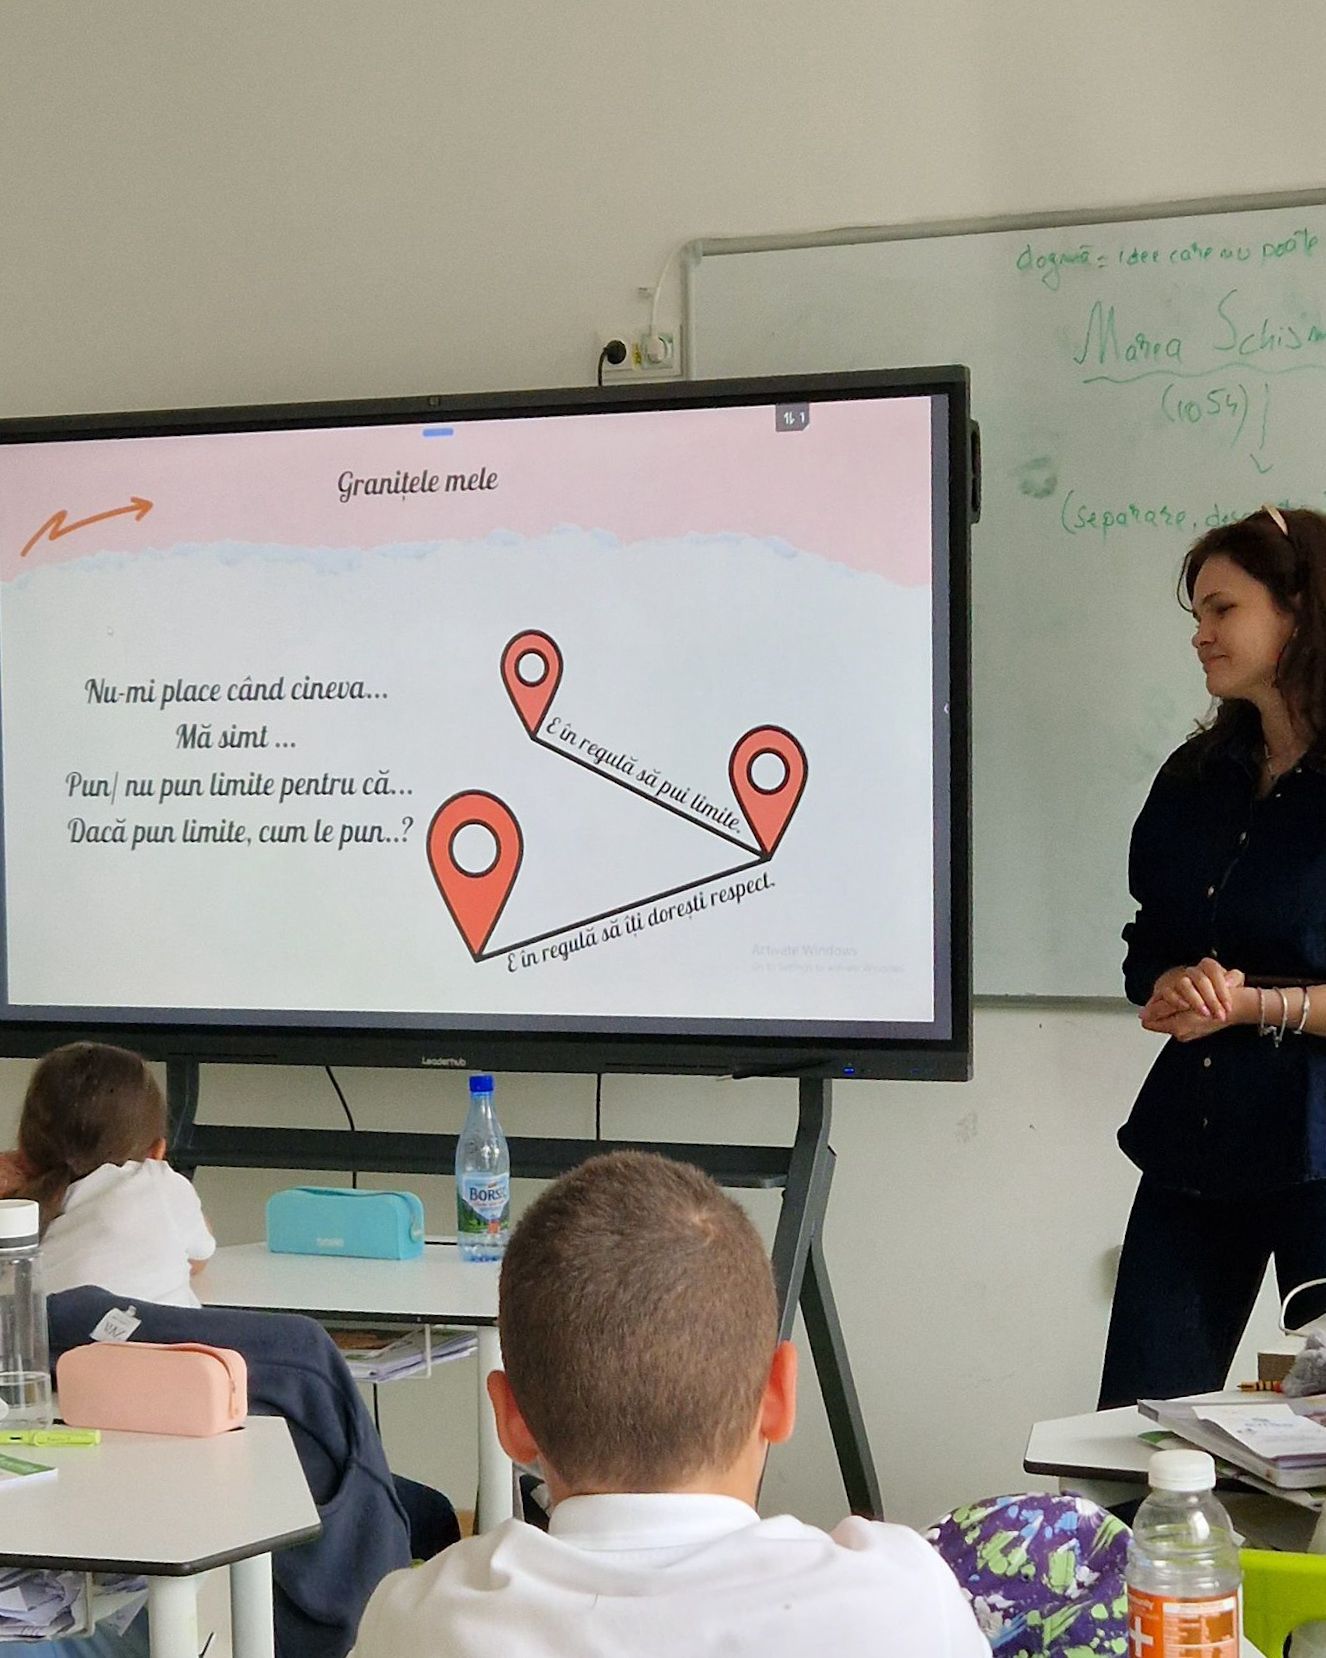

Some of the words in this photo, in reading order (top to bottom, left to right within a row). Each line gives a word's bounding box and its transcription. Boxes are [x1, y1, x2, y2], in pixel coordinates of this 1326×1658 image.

[1073, 300, 1182, 365] Marea
[337, 469, 441, 503] Granițele
[444, 466, 499, 492] mele
[85, 677, 156, 704] Nu-mi
[160, 678, 222, 710] place
[227, 674, 284, 702] când
[290, 675, 389, 701] cineva...
[176, 723, 212, 750] Mă
[218, 725, 268, 750] simt
[125, 781, 153, 797] nu
[159, 779, 204, 804] pun
[209, 772, 275, 797] limite
[279, 773, 356, 804] pentru
[362, 769, 414, 796] că...
[559, 723, 578, 747] în
[576, 736, 638, 776] regulă
[636, 768, 661, 788] să
[655, 780, 690, 805] pui
[690, 793, 742, 835] limite.
[67, 817, 127, 844] Dacă
[131, 822, 176, 851] pun
[182, 819, 252, 848] limite,
[258, 825, 308, 844] cum
[314, 819, 334, 843] le
[338, 816, 414, 851] pun..?
[520, 947, 539, 969] în
[540, 928, 598, 962] regulă
[601, 920, 622, 943] să
[647, 892, 708, 928] dorești
[709, 871, 776, 907] respect.
